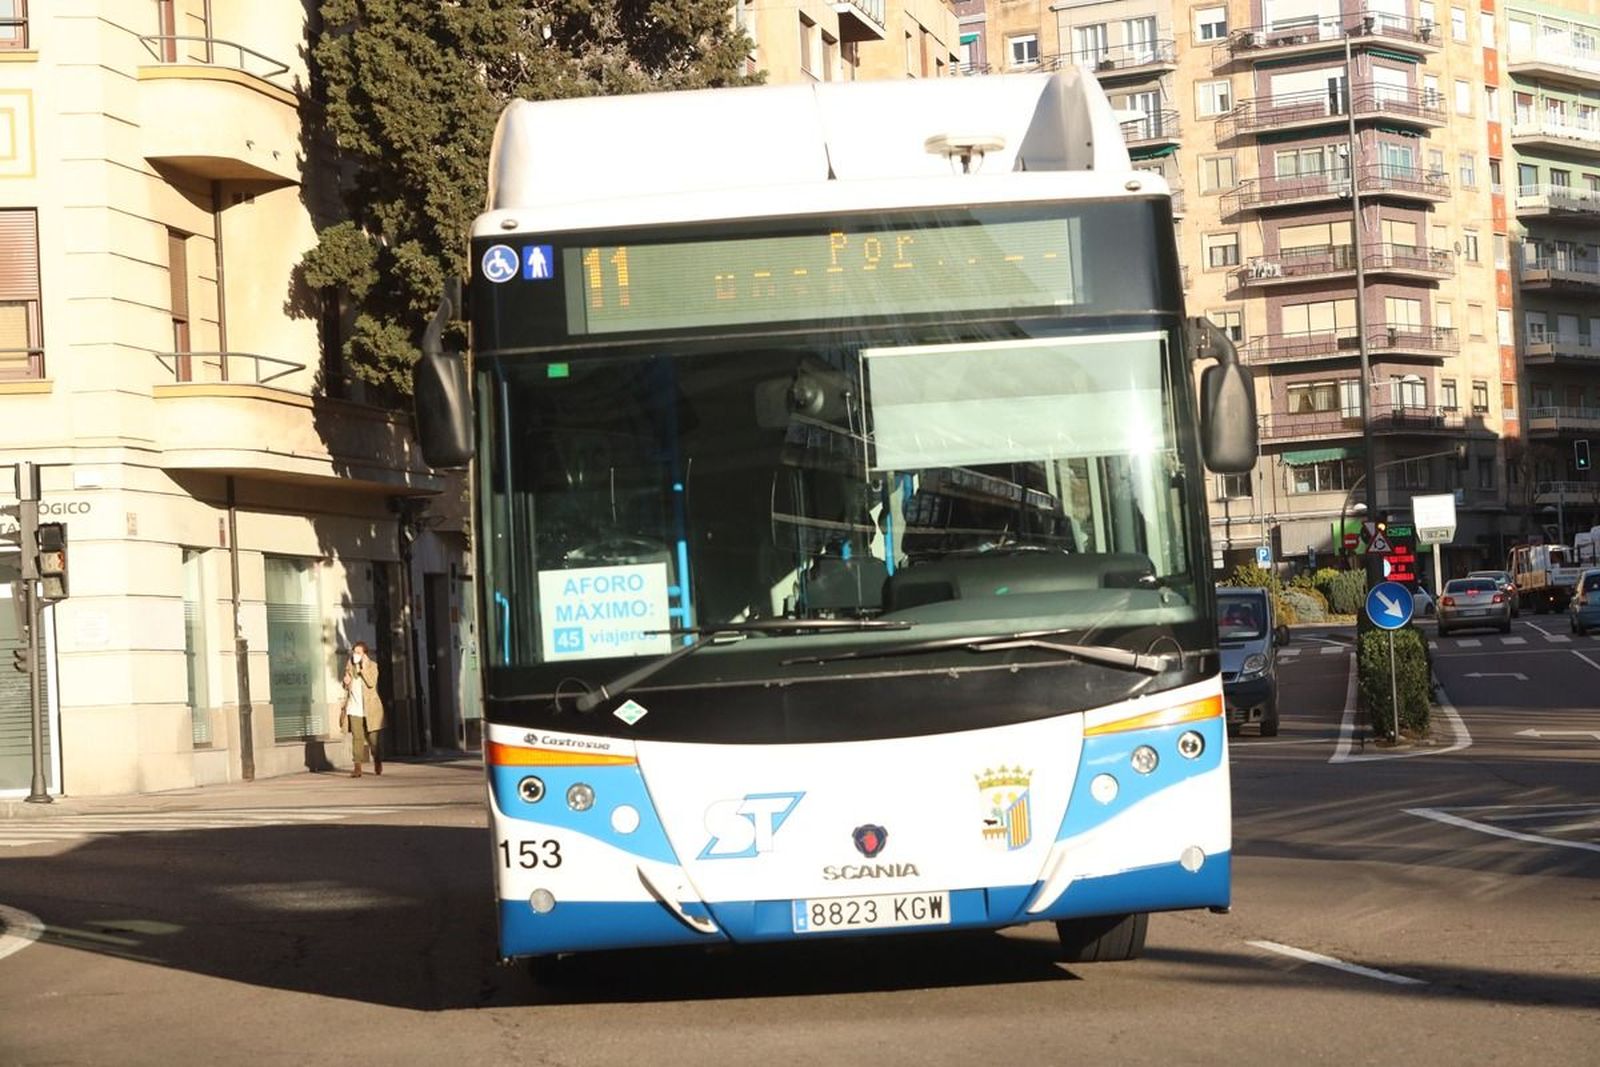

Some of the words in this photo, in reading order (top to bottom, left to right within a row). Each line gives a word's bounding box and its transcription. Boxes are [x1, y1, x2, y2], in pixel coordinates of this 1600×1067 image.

[583, 246, 630, 310] 11
[39, 500, 91, 515] ÓGICO
[563, 574, 644, 596] AFORO
[557, 631, 580, 648] 45
[590, 629, 660, 646] viajeros
[541, 735, 610, 751] Castrosua
[499, 839, 562, 869] 153
[823, 862, 920, 881] SCANIA
[811, 899, 878, 927] 8823
[894, 895, 943, 922] KGW
